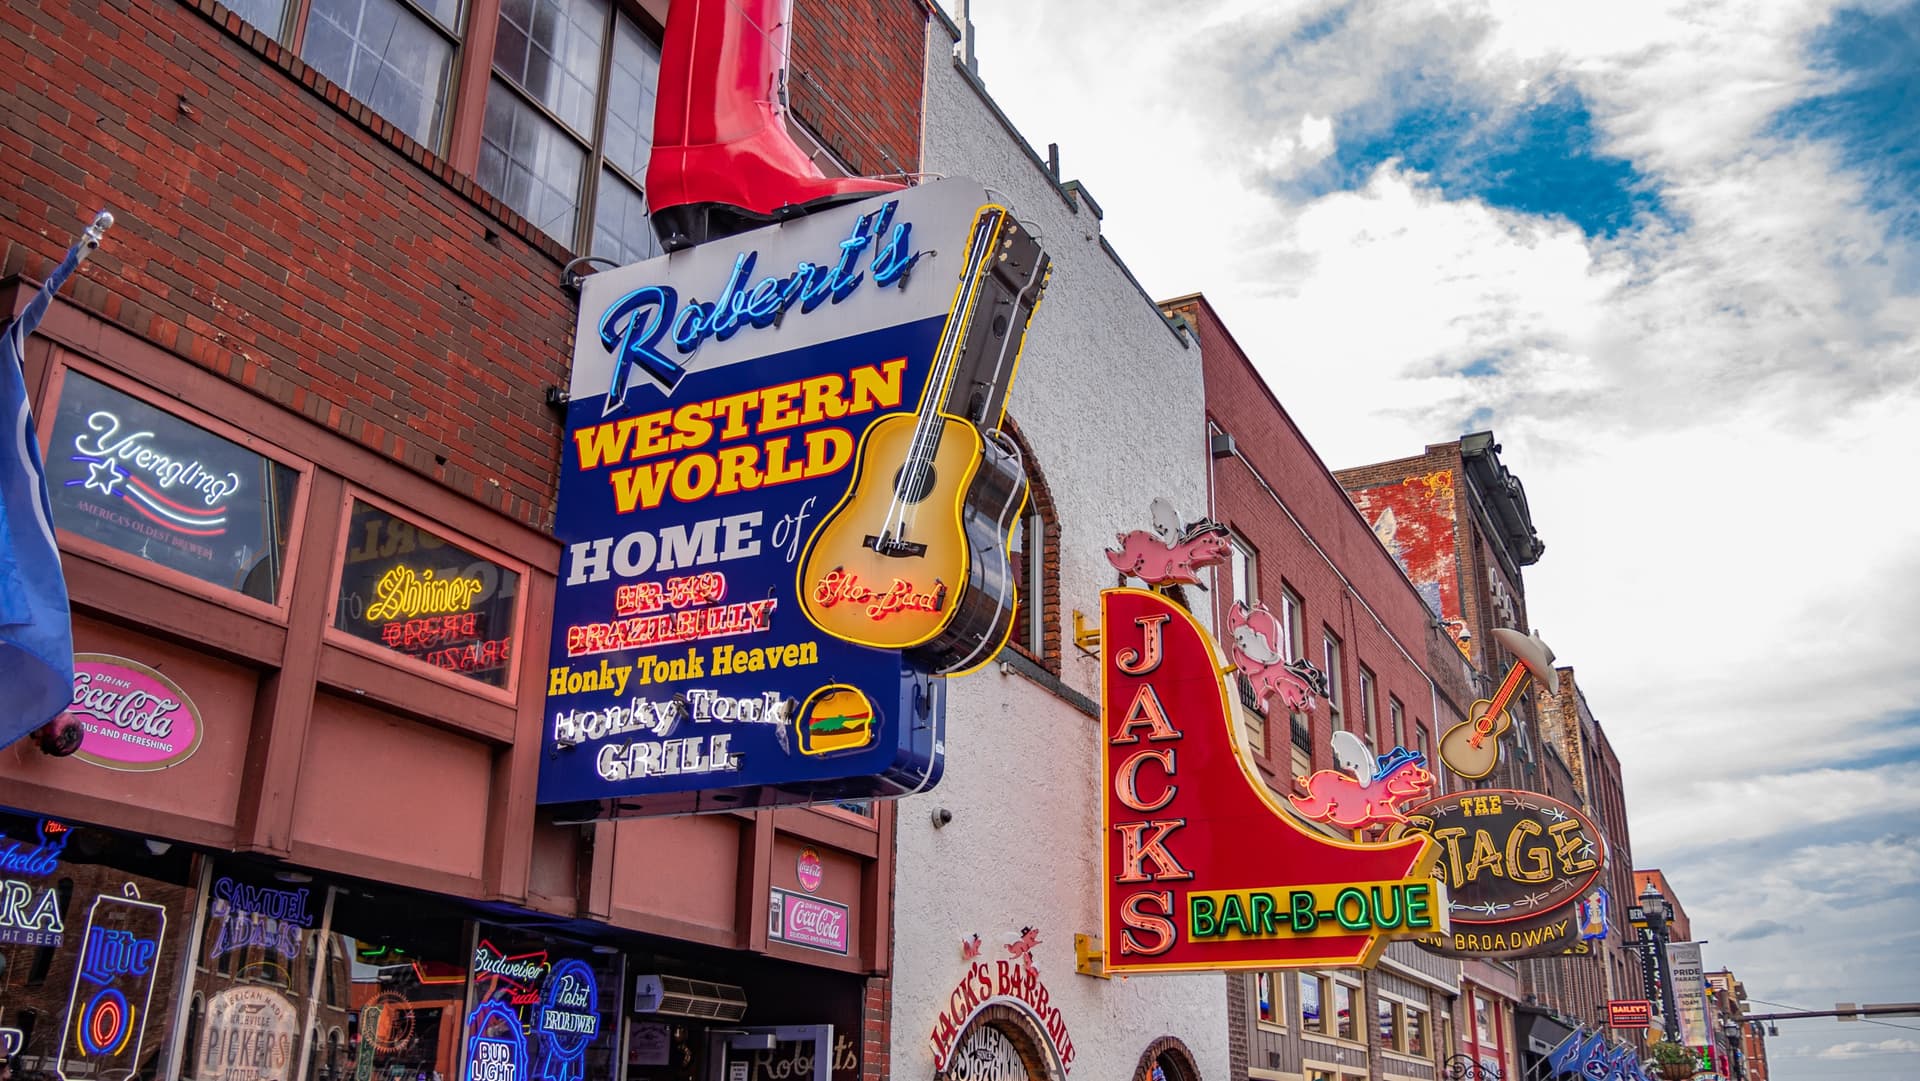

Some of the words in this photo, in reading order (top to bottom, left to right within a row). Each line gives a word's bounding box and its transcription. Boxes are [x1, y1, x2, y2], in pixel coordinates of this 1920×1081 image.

[599, 200, 918, 416] Robert's
[573, 357, 908, 472] WESTERN
[74, 411, 239, 505] Yuengling
[610, 426, 855, 513] WORLD
[131, 519, 170, 543] OLDEST
[566, 511, 763, 587] HOME
[772, 495, 815, 562] of
[366, 565, 483, 621] Shiner
[616, 571, 729, 617] BR-549
[813, 570, 946, 621] Sho-Bud
[566, 597, 778, 657] BRAZILBILLY
[95, 673, 132, 689] DRINK
[548, 656, 632, 697] Honky
[637, 648, 704, 684] Tonk
[711, 640, 818, 677] Heaven
[100, 727, 120, 739] AND
[122, 734, 173, 753] REFRESHING
[554, 697, 682, 750] Honky
[687, 689, 793, 726] Tonk
[597, 733, 739, 781] GRILL
[1110, 614, 1194, 956] JACKS
[1460, 795, 1502, 817] THE
[0, 842, 62, 874] helob
[0, 879, 64, 932] RA
[212, 877, 313, 926] SAMUEL
[791, 901, 841, 939] Coca-Cola
[1190, 884, 1433, 937] BAR-B-QUE
[27, 932, 62, 945] BEER
[82, 925, 155, 985] Lite
[210, 916, 301, 959] ADAMS
[1455, 919, 1569, 951] BROADWAY
[474, 948, 543, 979] Budweiser
[1673, 968, 1701, 976] PRIDE
[559, 975, 591, 1007] Pabst
[1612, 1005, 1647, 1013] BAILEY'S
[929, 961, 993, 1071] JACK'S
[206, 1027, 289, 1069] PICKERS
[471, 1060, 515, 1081] LIGHT
[480, 1041, 510, 1063] BUD
